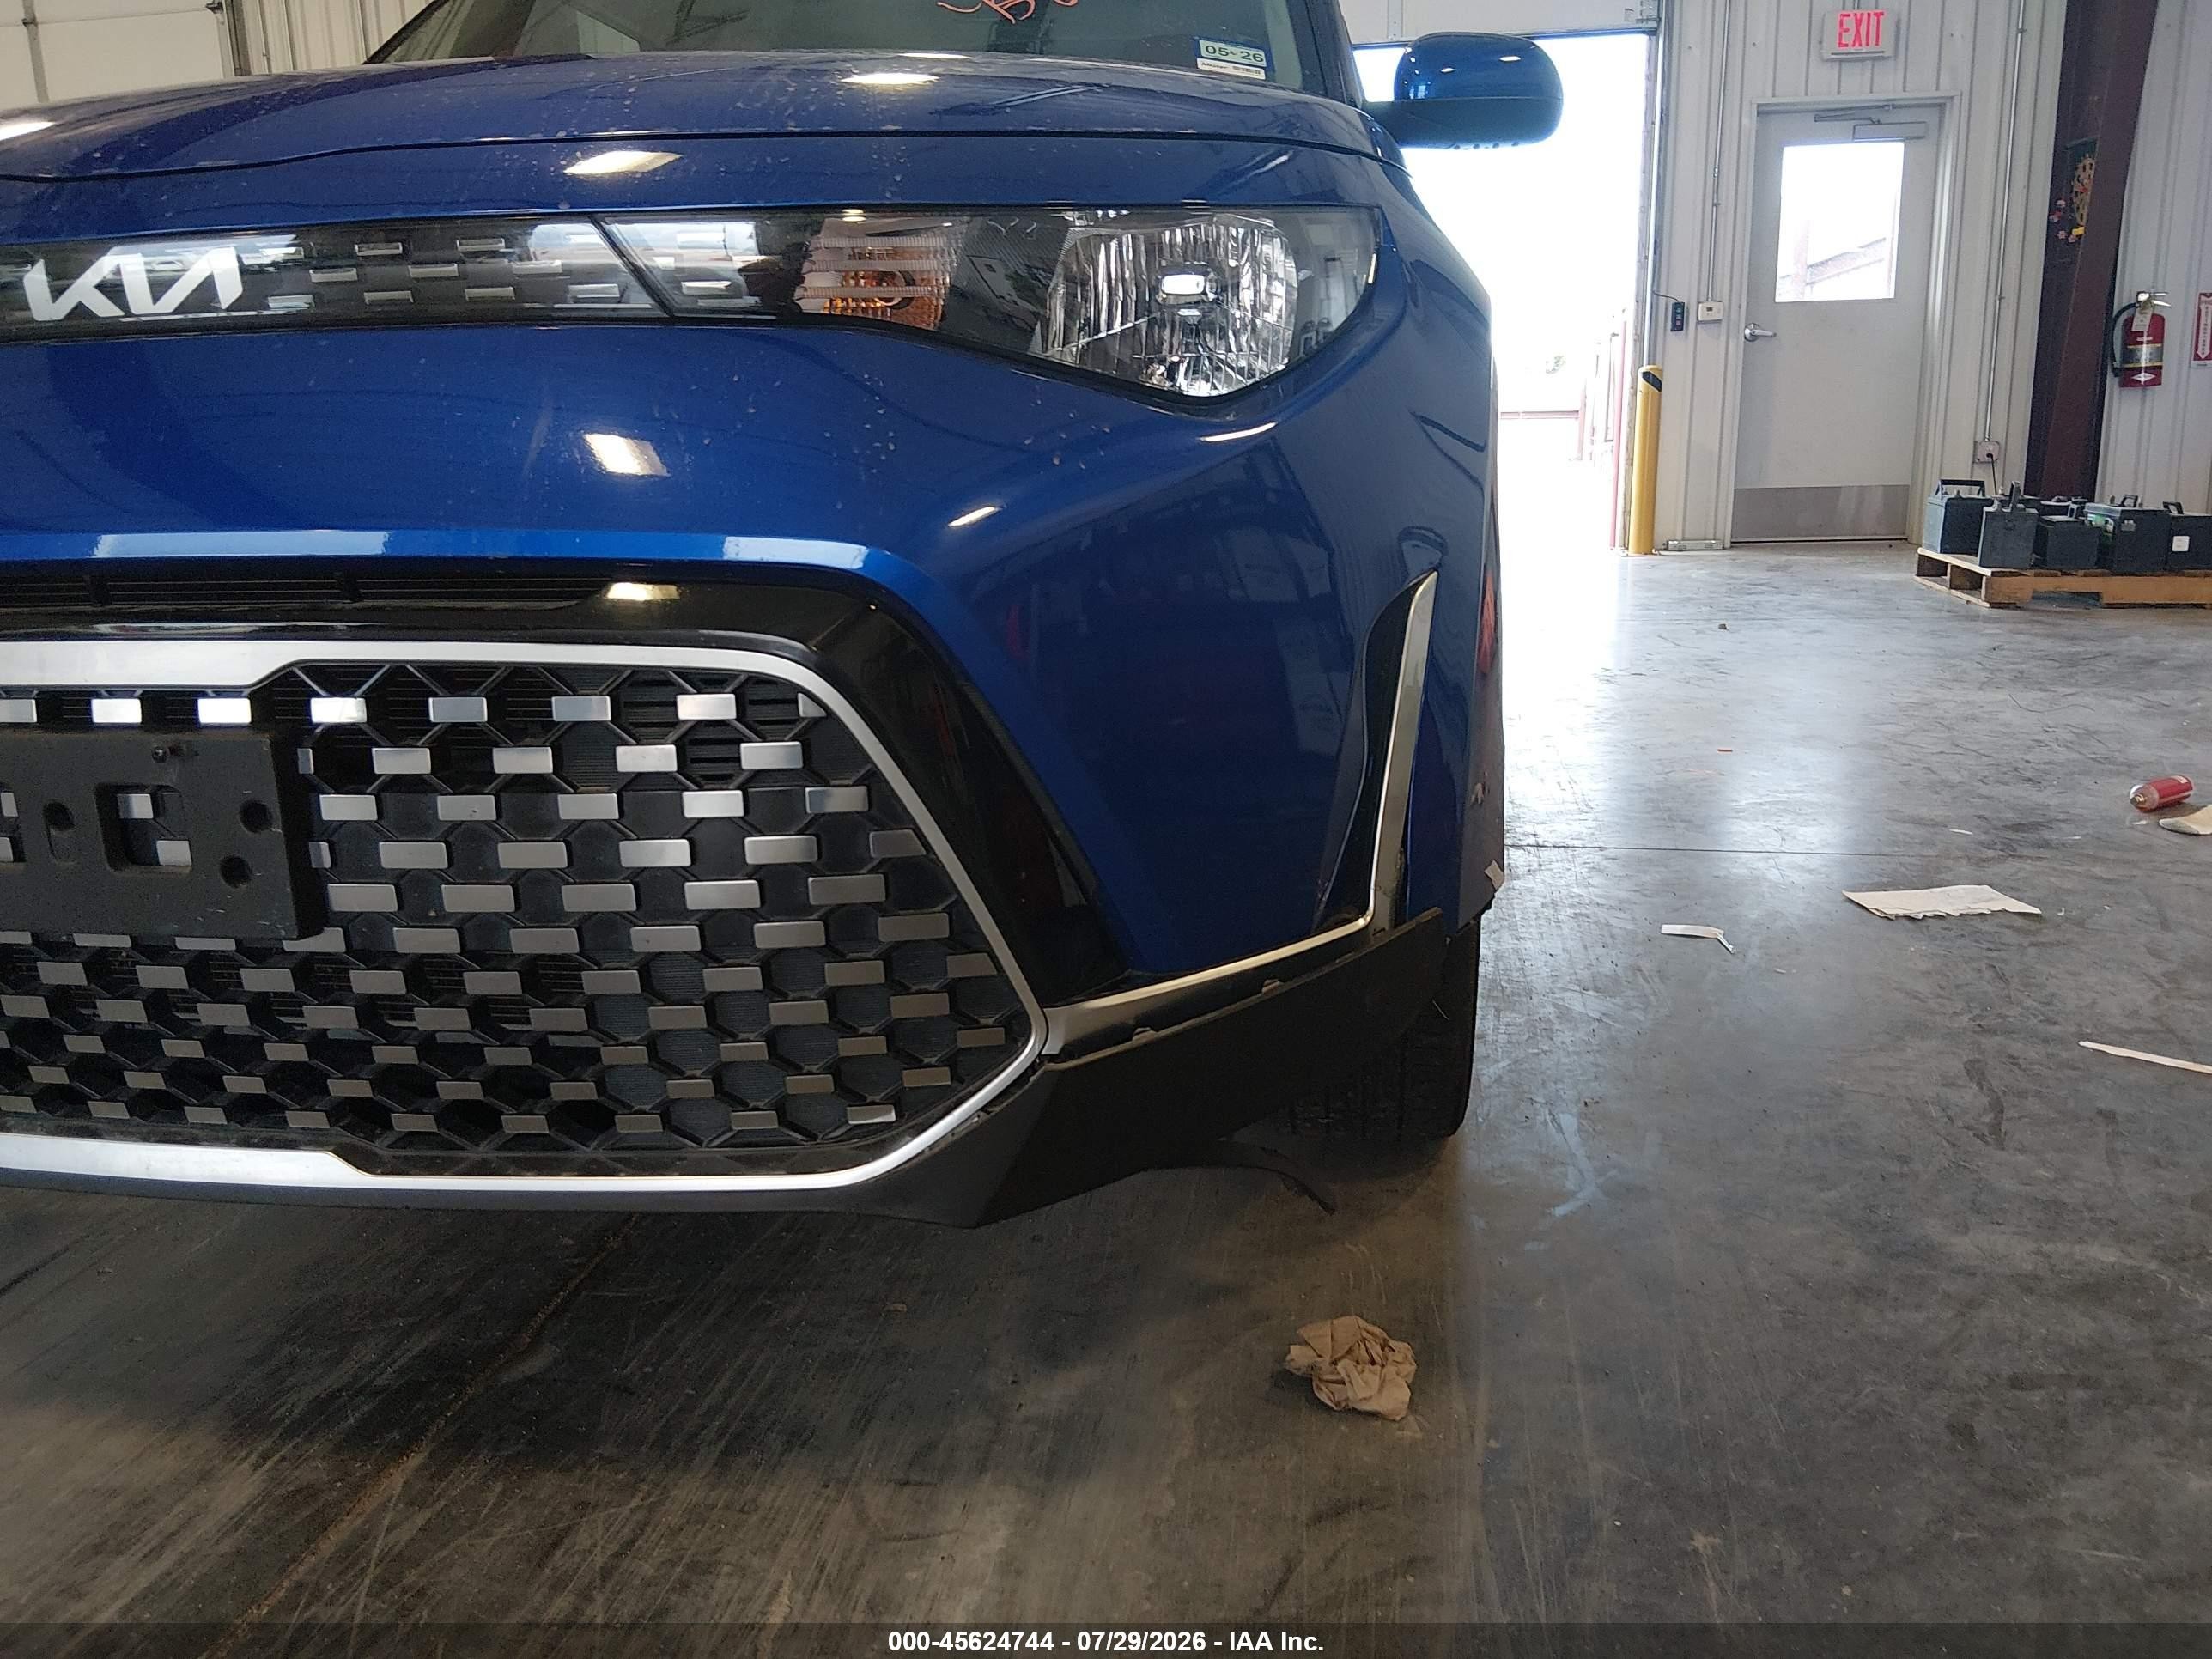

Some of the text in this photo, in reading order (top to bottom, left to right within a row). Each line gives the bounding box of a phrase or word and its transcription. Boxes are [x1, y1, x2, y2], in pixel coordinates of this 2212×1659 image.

[1838, 11, 1884, 47] EXIT
[1206, 45, 1264, 63] 05 26
[23, 246, 243, 321] KIA
